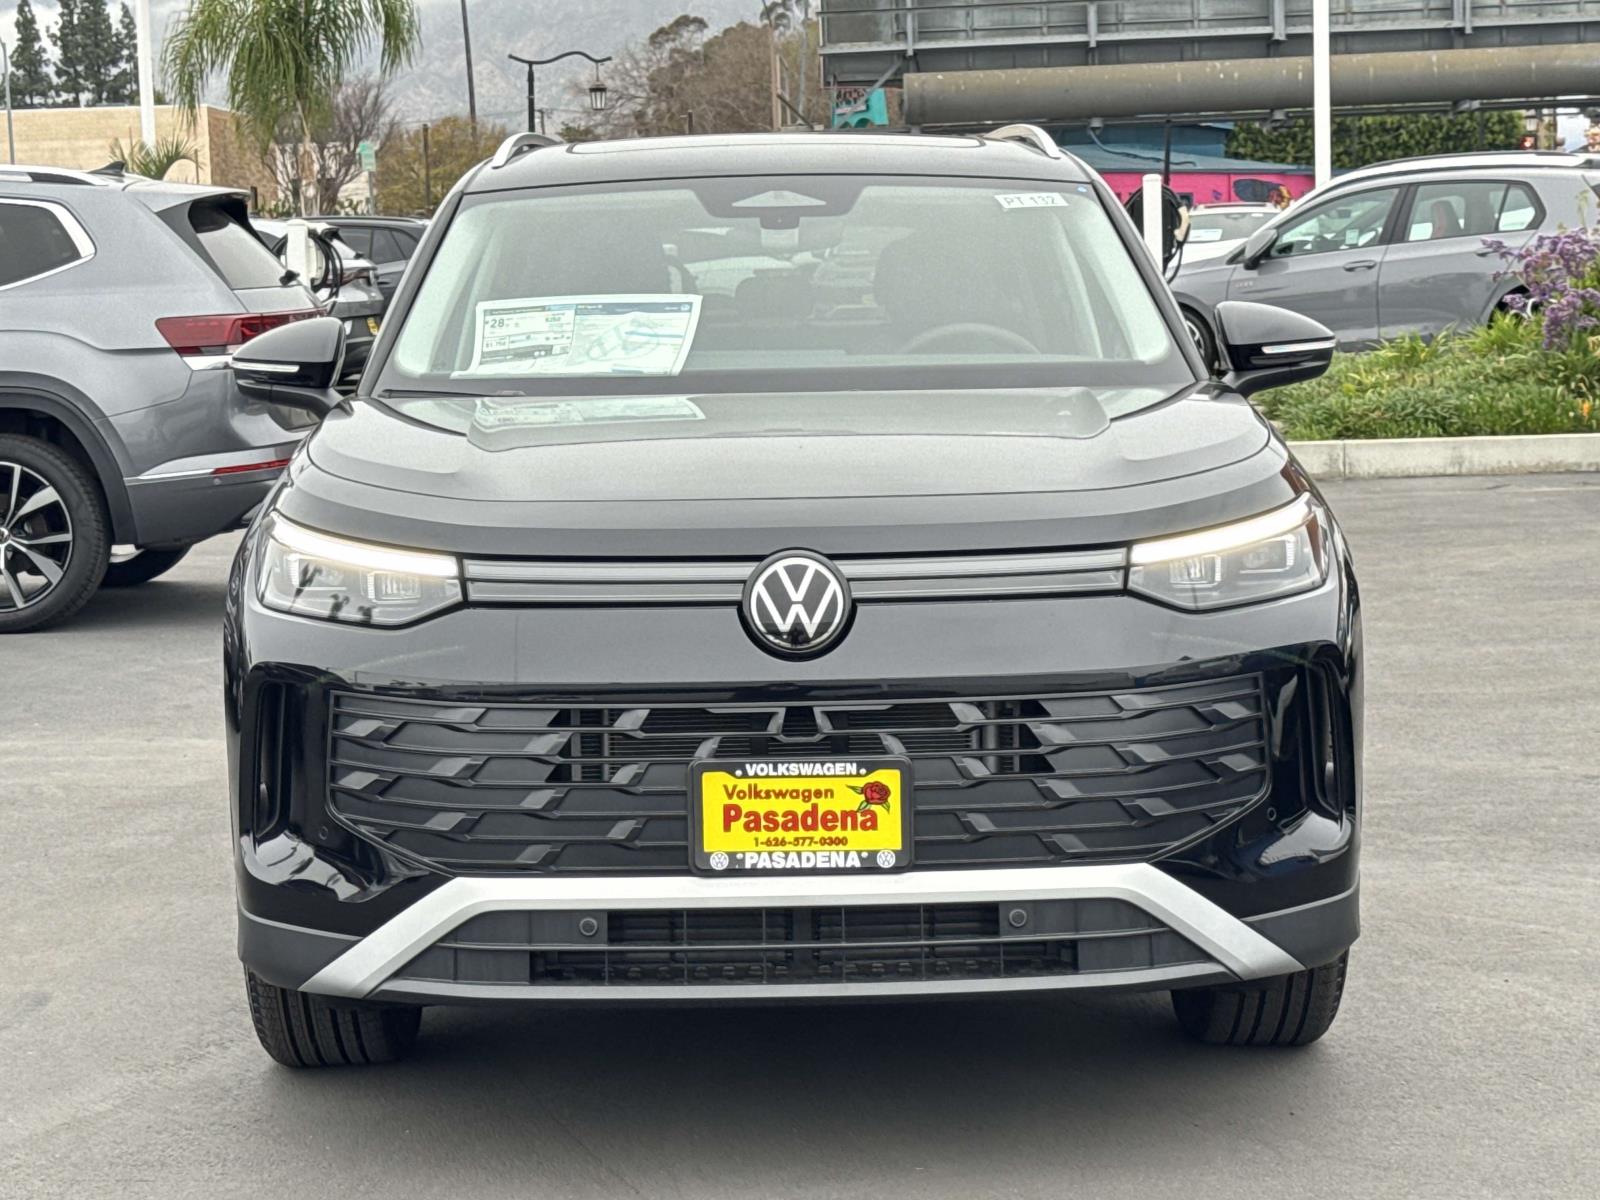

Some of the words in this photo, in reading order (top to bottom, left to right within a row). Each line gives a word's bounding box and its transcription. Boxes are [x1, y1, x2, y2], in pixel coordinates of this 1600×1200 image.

[1004, 196, 1024, 206] PT
[490, 318, 505, 329] 28
[745, 763, 857, 777] VOLKSWAGEN
[722, 784, 835, 803] Volkswagen
[722, 803, 879, 833] Pasadena
[754, 836, 848, 847] 1-626-577-0300
[744, 851, 862, 869] PASADENA
